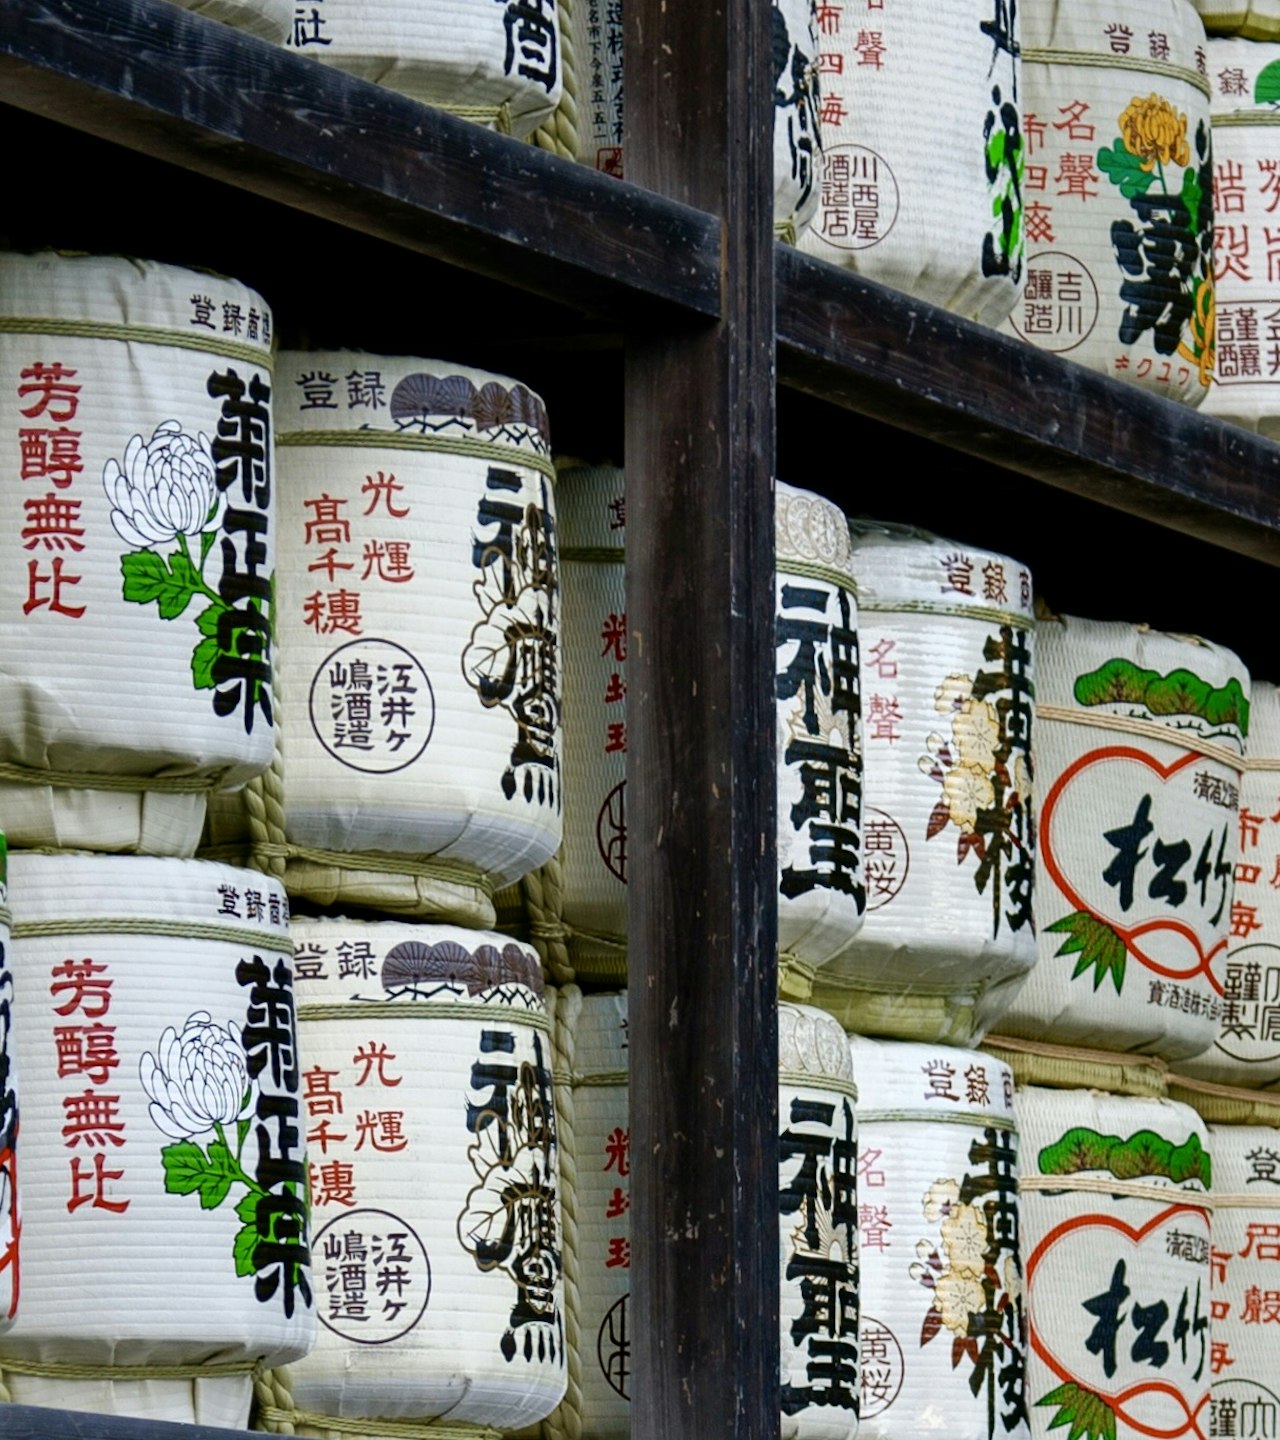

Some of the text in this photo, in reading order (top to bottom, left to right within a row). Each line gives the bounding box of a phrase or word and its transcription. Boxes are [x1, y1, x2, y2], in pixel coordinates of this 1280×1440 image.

[17, 361, 86, 621] 芳醇無比
[295, 369, 388, 412] 登録
[206, 366, 273, 736] 菊正宗
[360, 470, 416, 585] 光輝
[50, 958, 131, 1215] 芳醇無比
[235, 954, 313, 1320] 菊正宗
[352, 1040, 410, 1154] 光輝
